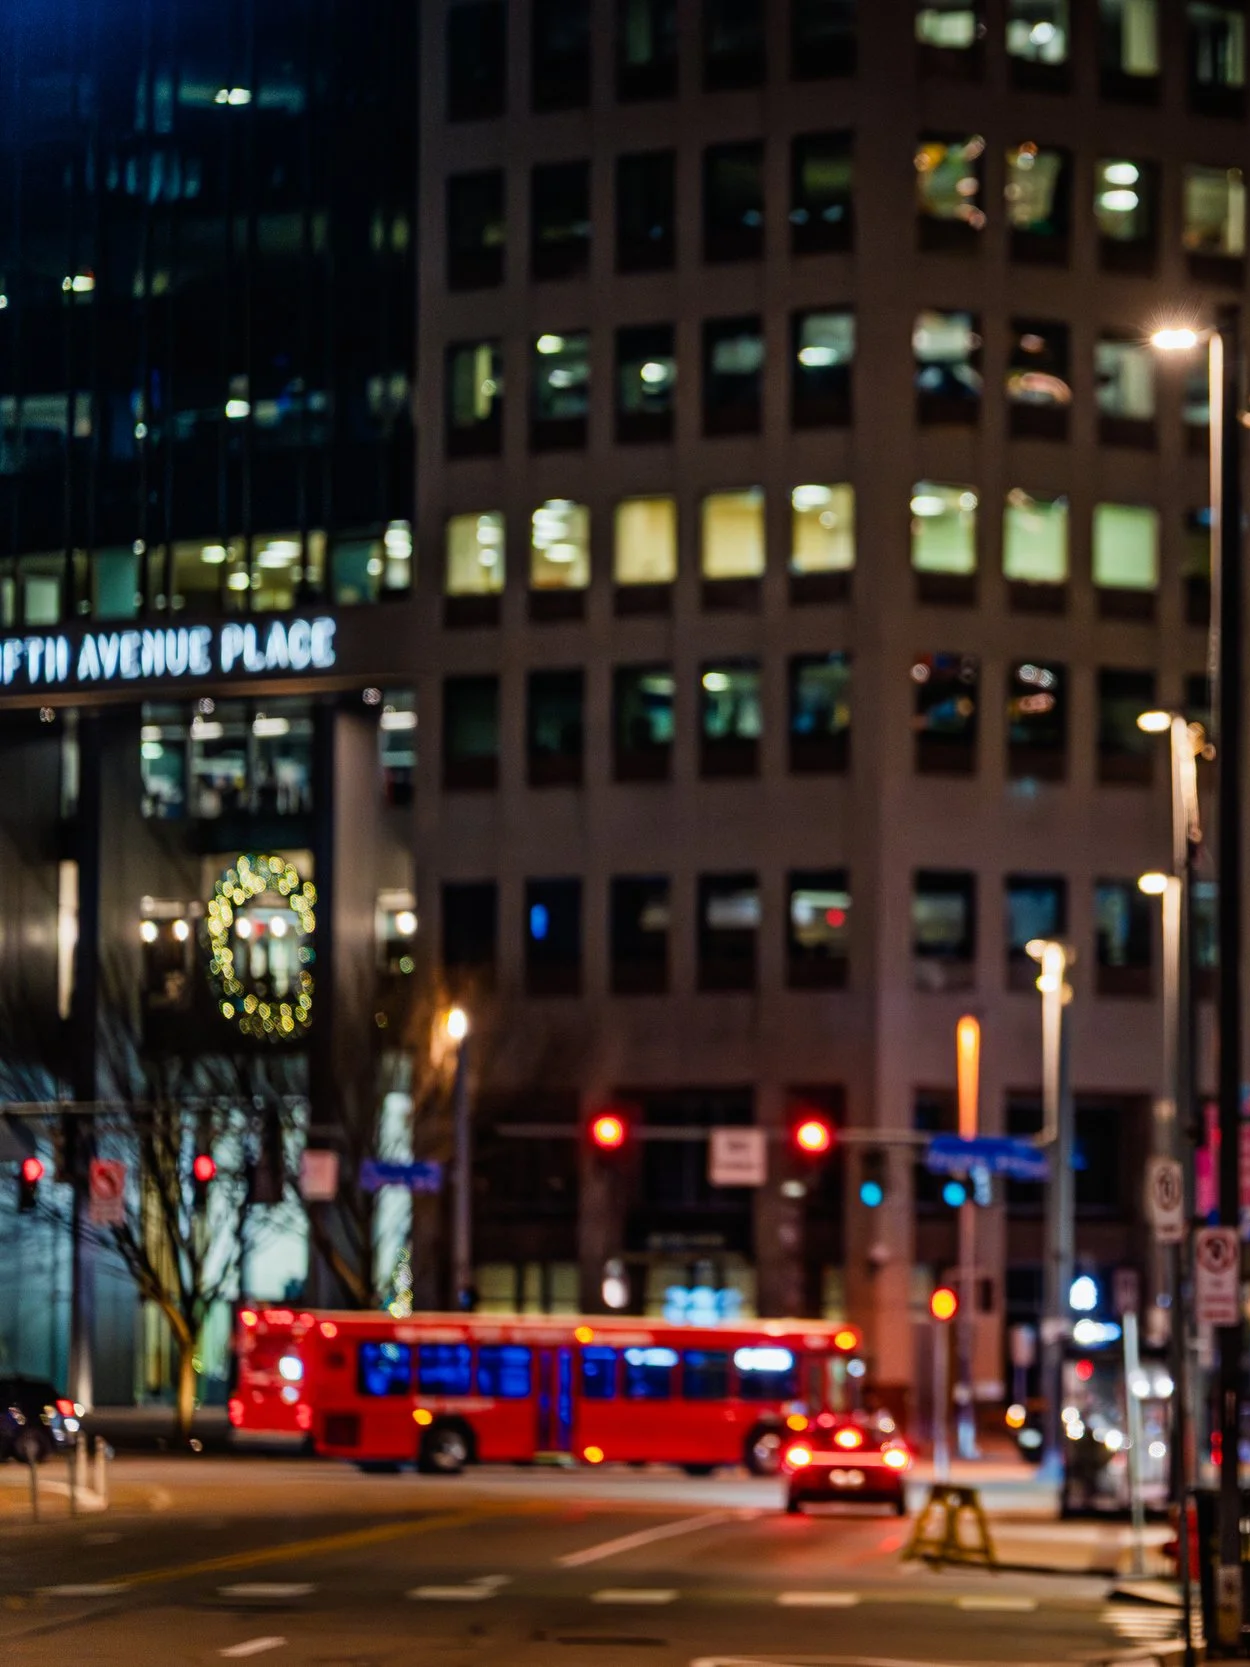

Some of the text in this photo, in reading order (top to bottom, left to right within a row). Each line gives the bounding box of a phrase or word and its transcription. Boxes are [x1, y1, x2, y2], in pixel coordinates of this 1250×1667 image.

[0, 616, 337, 685] FTH AVENUE PLACE
